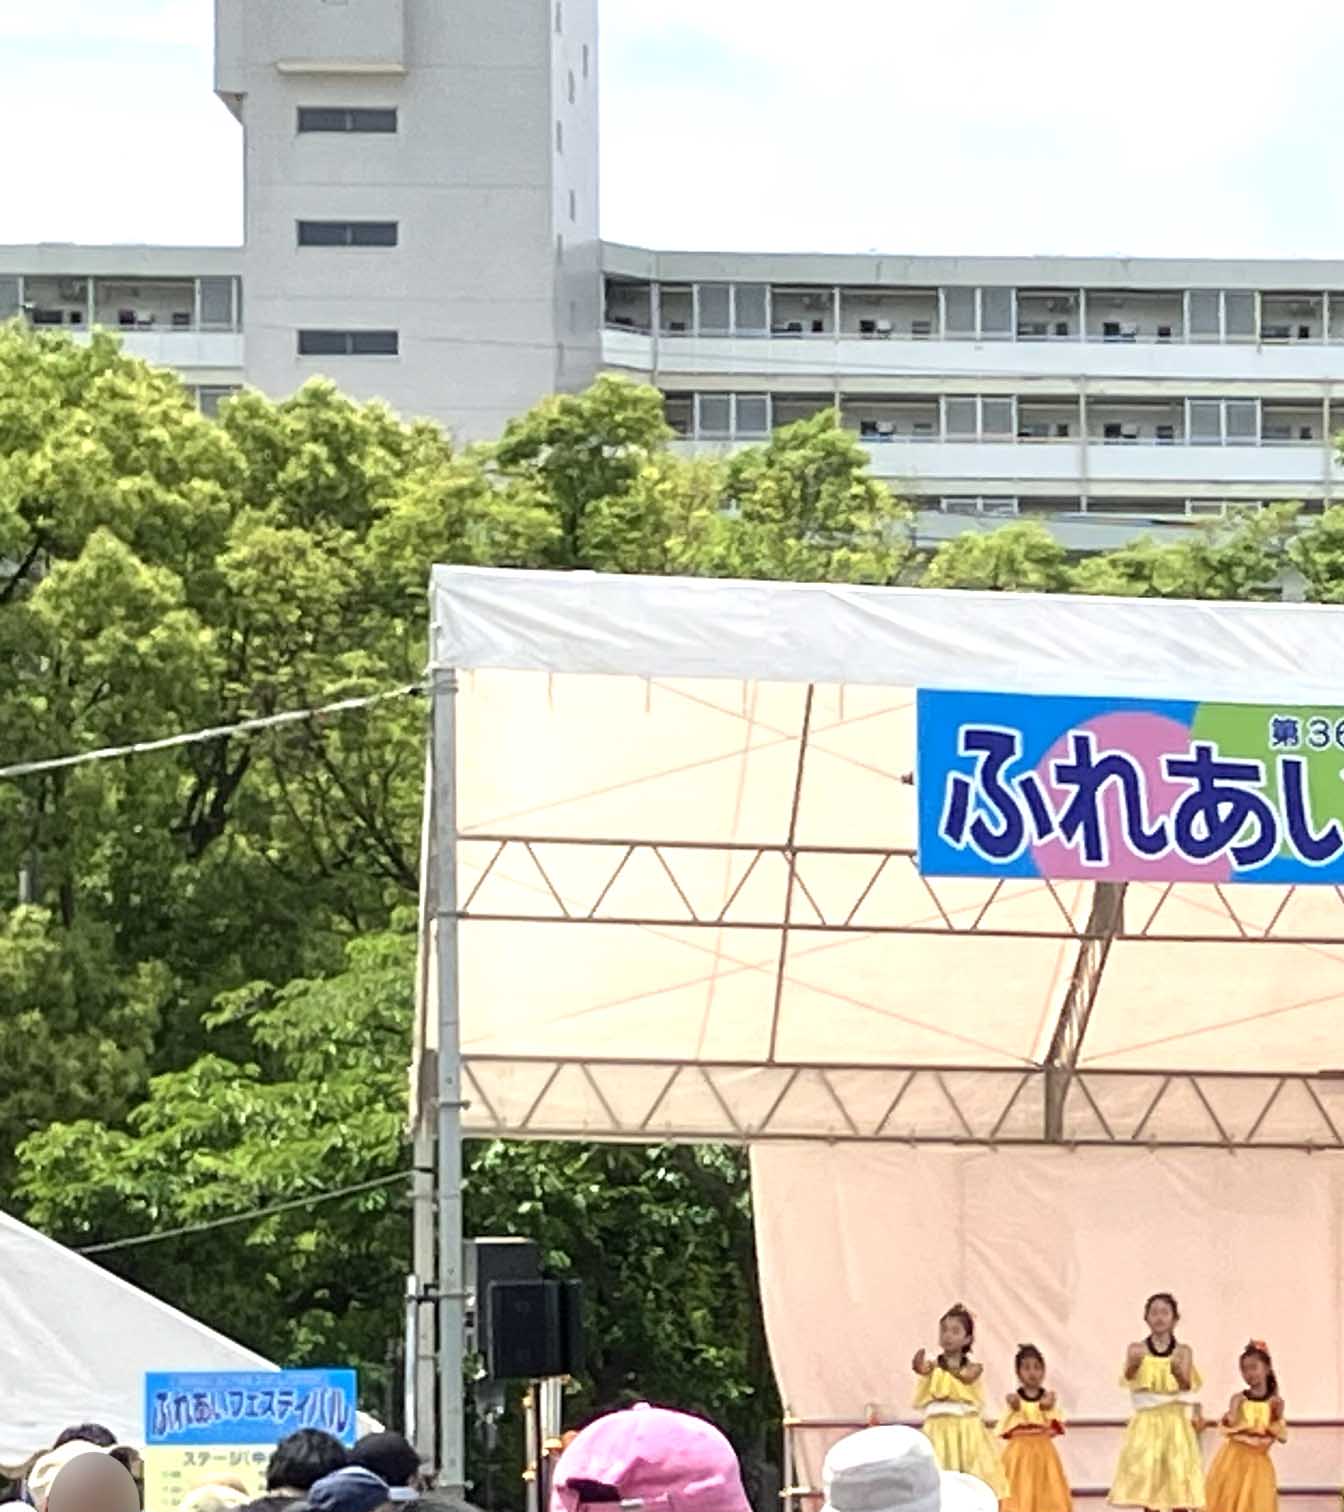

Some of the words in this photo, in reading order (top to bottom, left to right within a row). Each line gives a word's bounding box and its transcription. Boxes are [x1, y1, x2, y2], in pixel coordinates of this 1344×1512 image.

[152, 1389, 350, 1437] ふれあいフェスティバル
